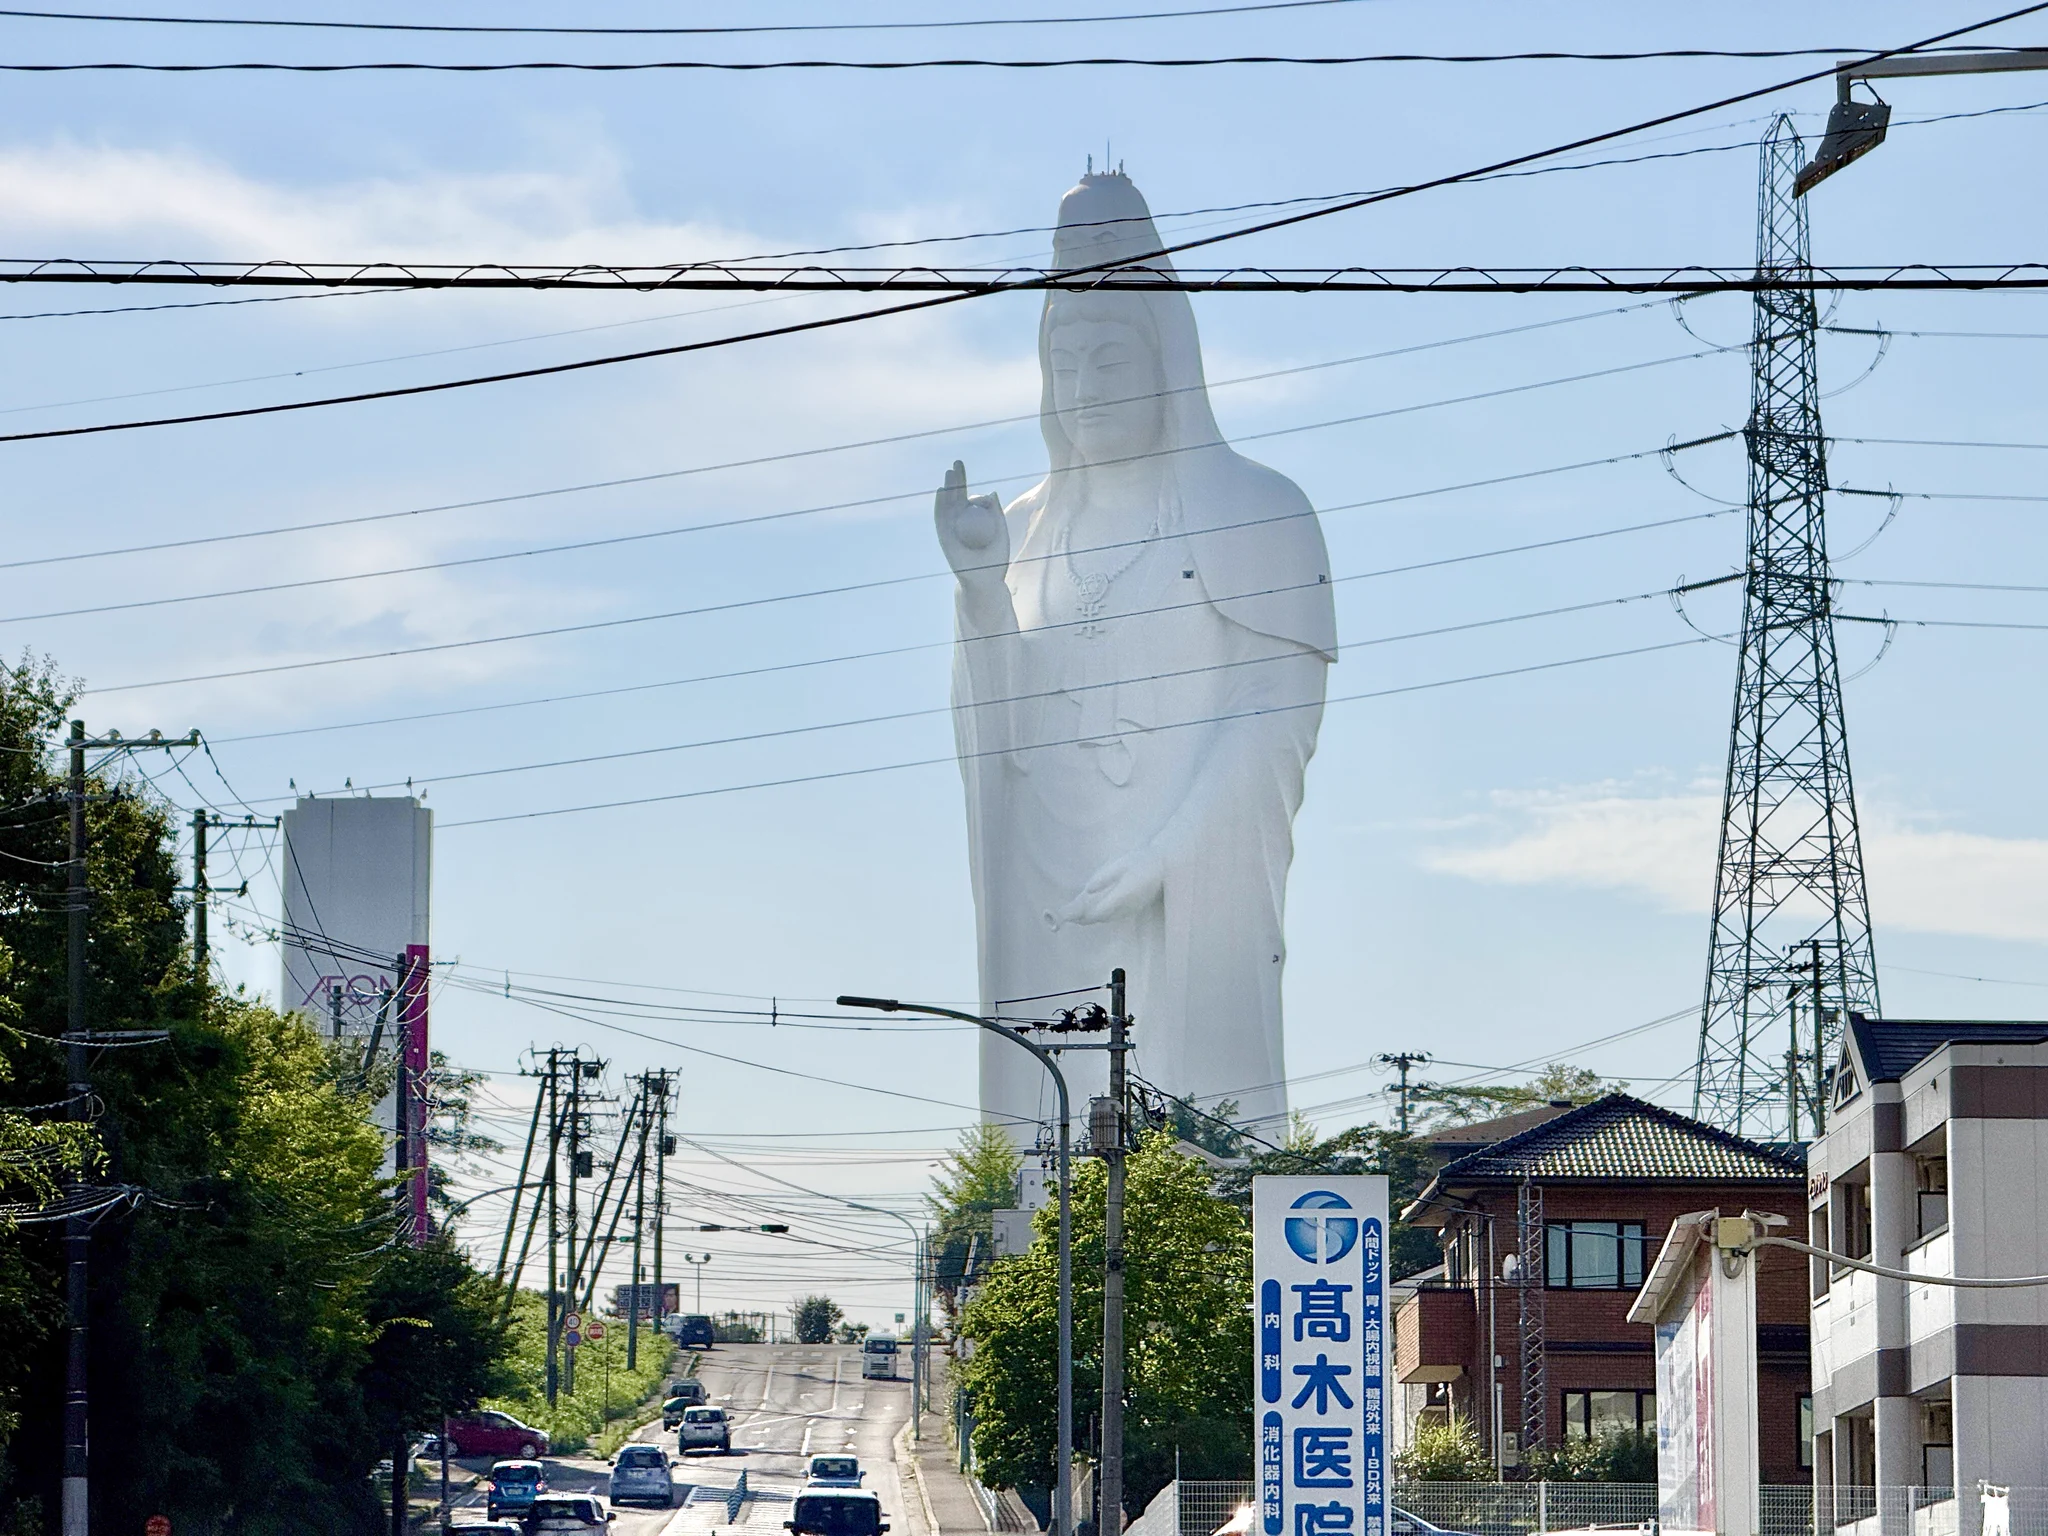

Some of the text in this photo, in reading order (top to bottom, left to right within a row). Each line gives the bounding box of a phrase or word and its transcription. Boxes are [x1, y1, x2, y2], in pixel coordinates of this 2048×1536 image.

[1364, 1225, 1380, 1283] 人間ドック
[568, 1317, 578, 1326] 40
[1264, 1312, 1280, 1370] 内科
[1365, 1295, 1380, 1377] 胃・大腸内視鏡
[1365, 1387, 1381, 1435] 糖尿外来
[1263, 1426, 1280, 1519] 消化器内科
[1366, 1446, 1382, 1504] IBD外来
